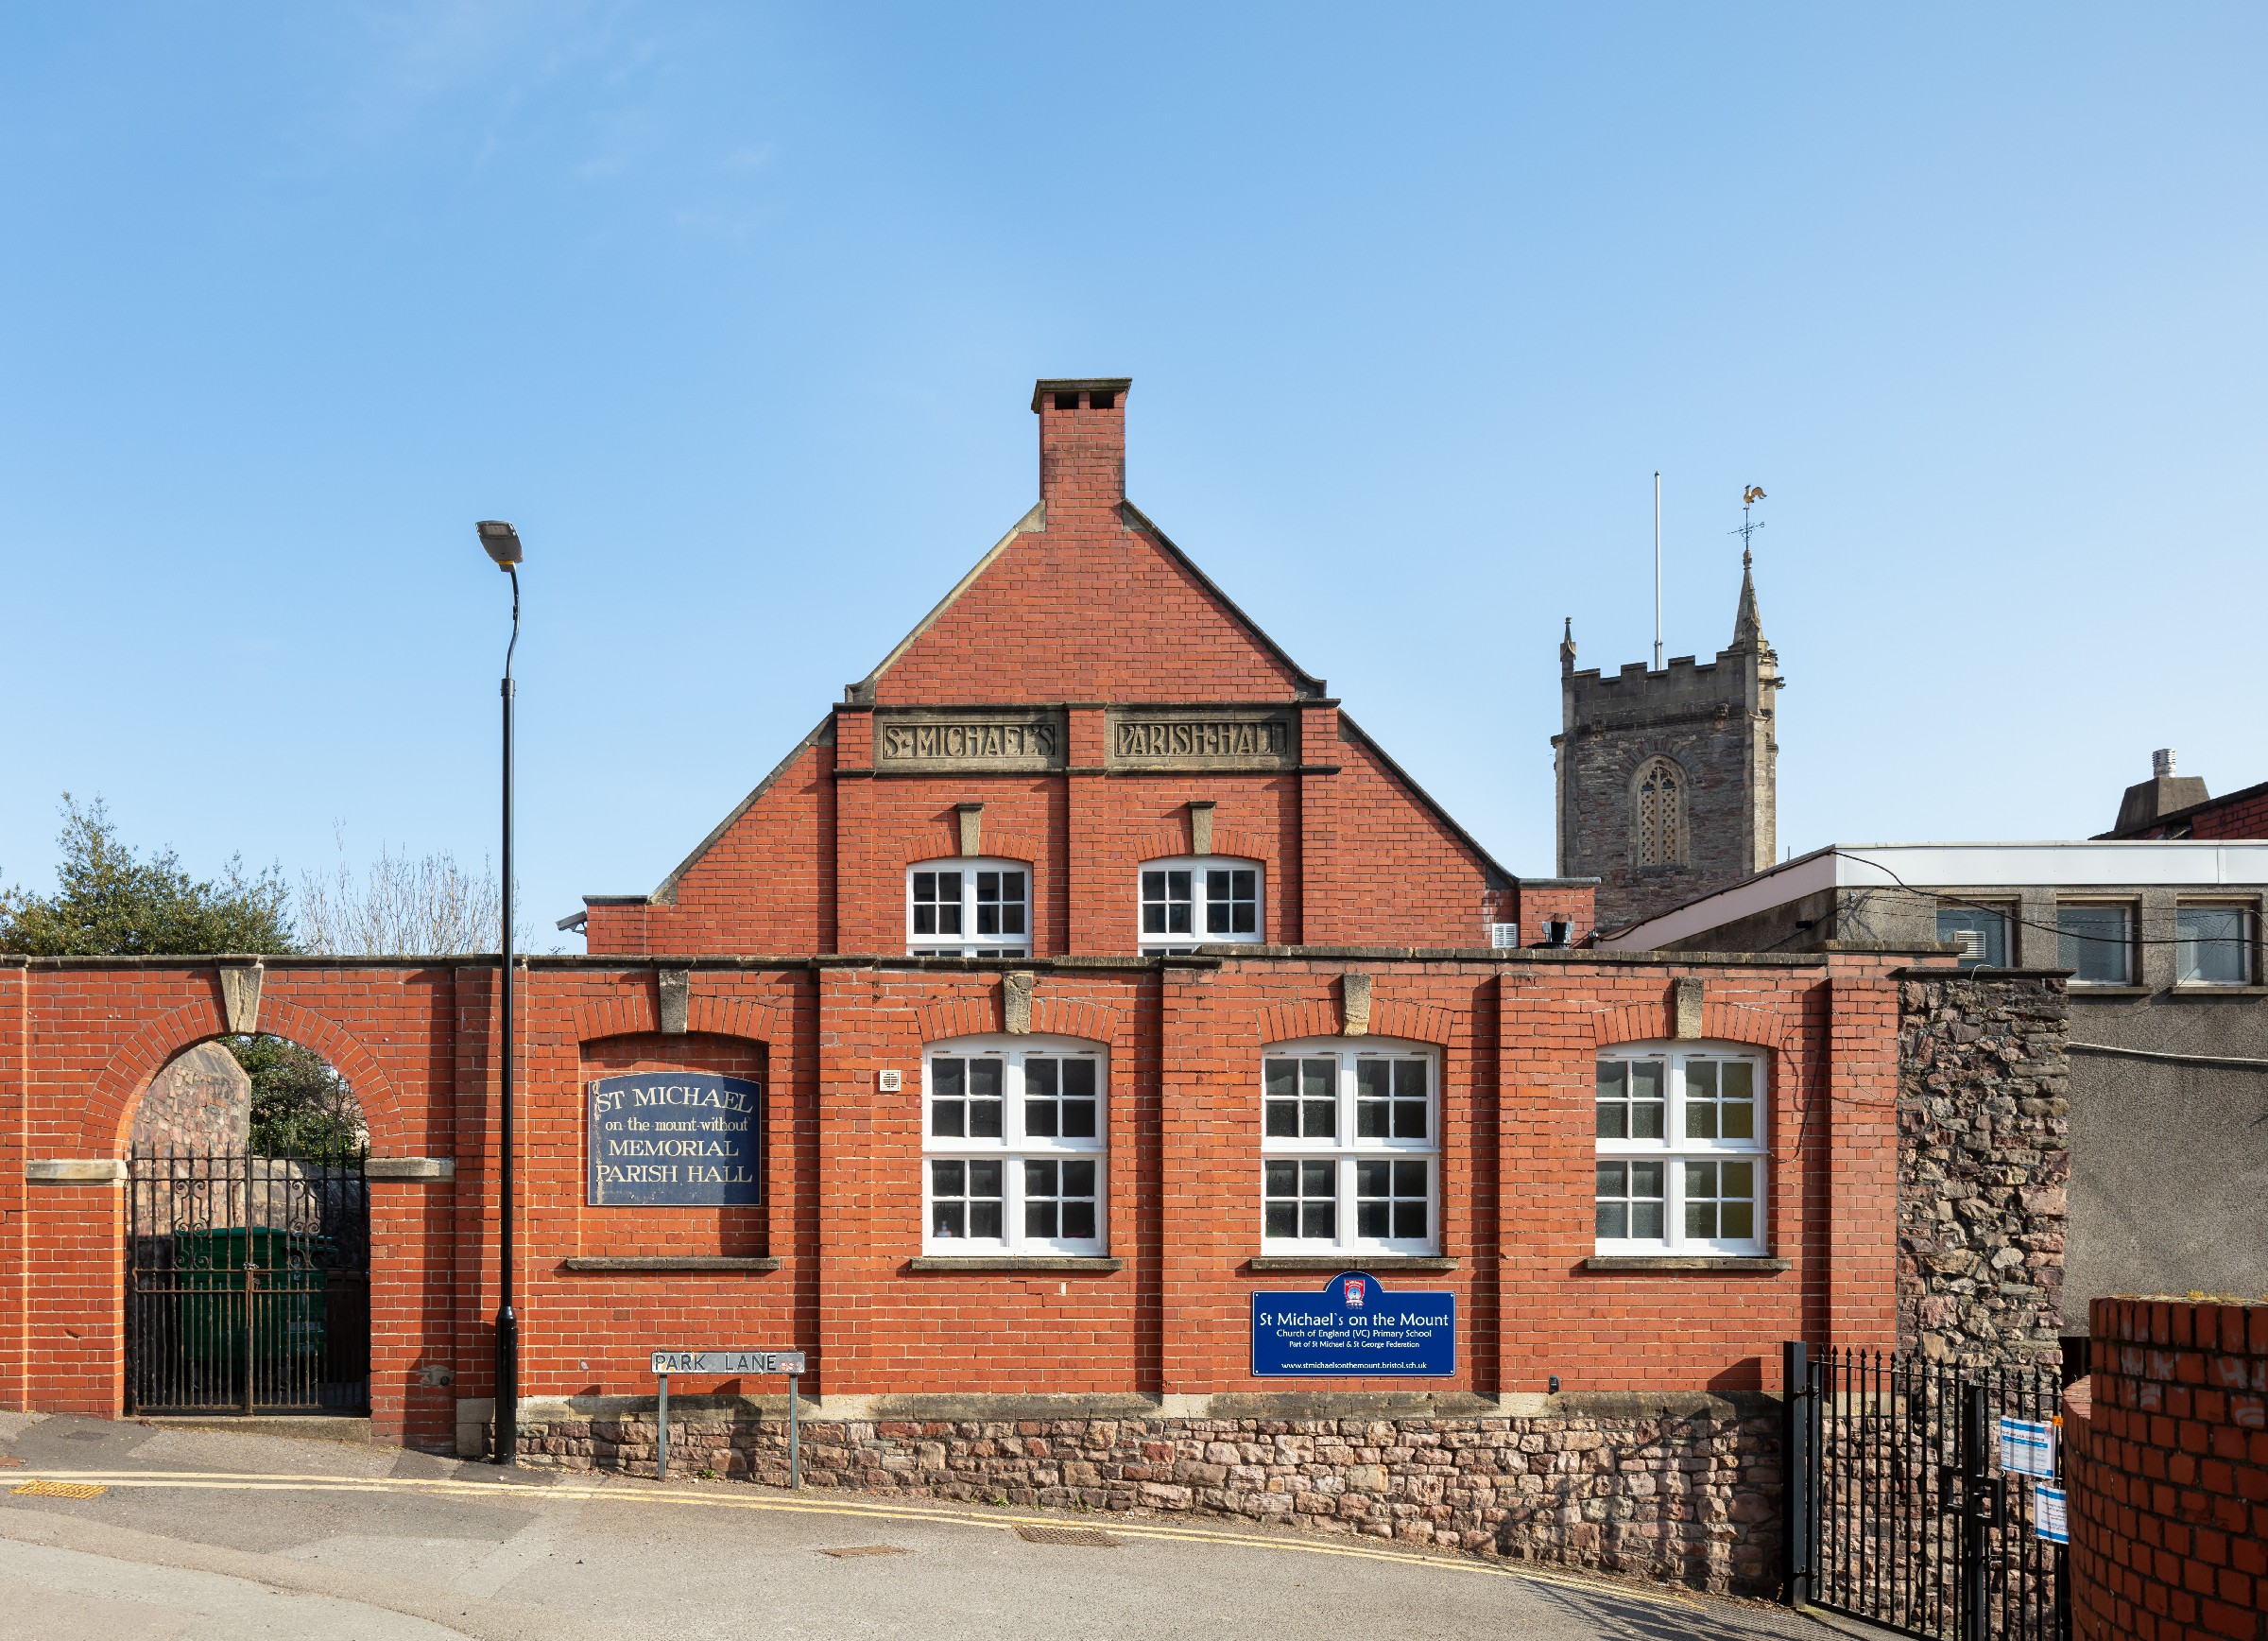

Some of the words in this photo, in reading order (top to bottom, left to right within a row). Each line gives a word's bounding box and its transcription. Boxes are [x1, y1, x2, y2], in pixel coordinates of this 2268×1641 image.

[1119, 723, 1212, 755] PARISH
[1217, 723, 1287, 755] HALL
[597, 1090, 626, 1113] ST
[632, 1086, 754, 1114] MICHAEL
[608, 1139, 739, 1157] MEMORIAL
[596, 1165, 679, 1183] PARISH
[687, 1166, 753, 1183] HALL
[1260, 1312, 1273, 1326] St
[1349, 1316, 1368, 1326] on
[1372, 1312, 1396, 1326] the
[1400, 1312, 1450, 1326] Mount
[1276, 1329, 1305, 1338] Church
[1307, 1329, 1316, 1338] of
[1318, 1329, 1350, 1339] England
[1352, 1329, 1370, 1339] (VC)
[1372, 1329, 1404, 1339] Primary
[1405, 1329, 1432, 1338] School
[1361, 1340, 1384, 1349] George
[655, 1354, 707, 1372] PARK
[725, 1354, 777, 1372] LANE
